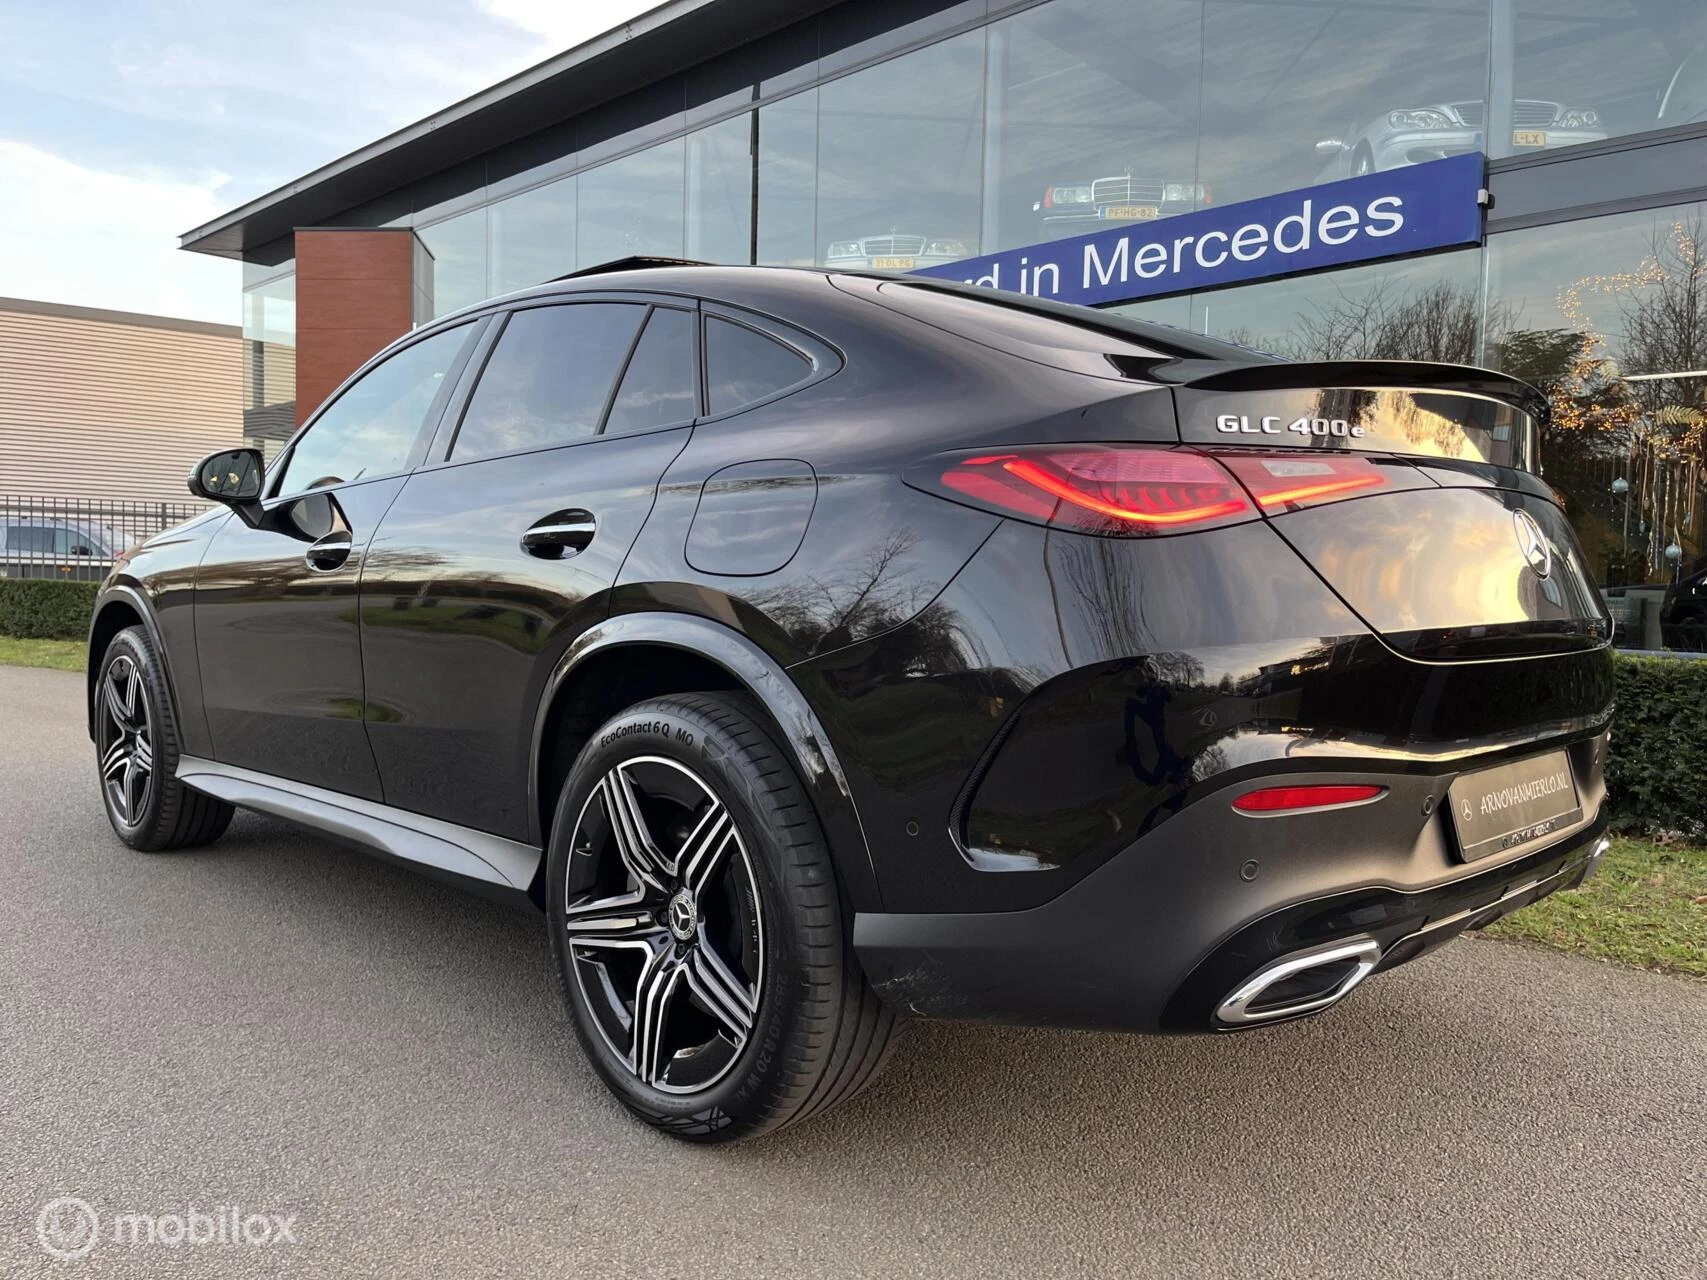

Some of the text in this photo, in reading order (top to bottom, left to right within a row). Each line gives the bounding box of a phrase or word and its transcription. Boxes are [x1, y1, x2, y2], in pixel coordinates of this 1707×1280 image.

[1020, 257, 1059, 296] in
[1082, 195, 1404, 289] Mercedes
[1216, 414, 1281, 434] GLC
[601, 721, 651, 748] EcoContact
[675, 728, 694, 746] MO
[1480, 771, 1569, 817] ARNOVANMIERLO.NL
